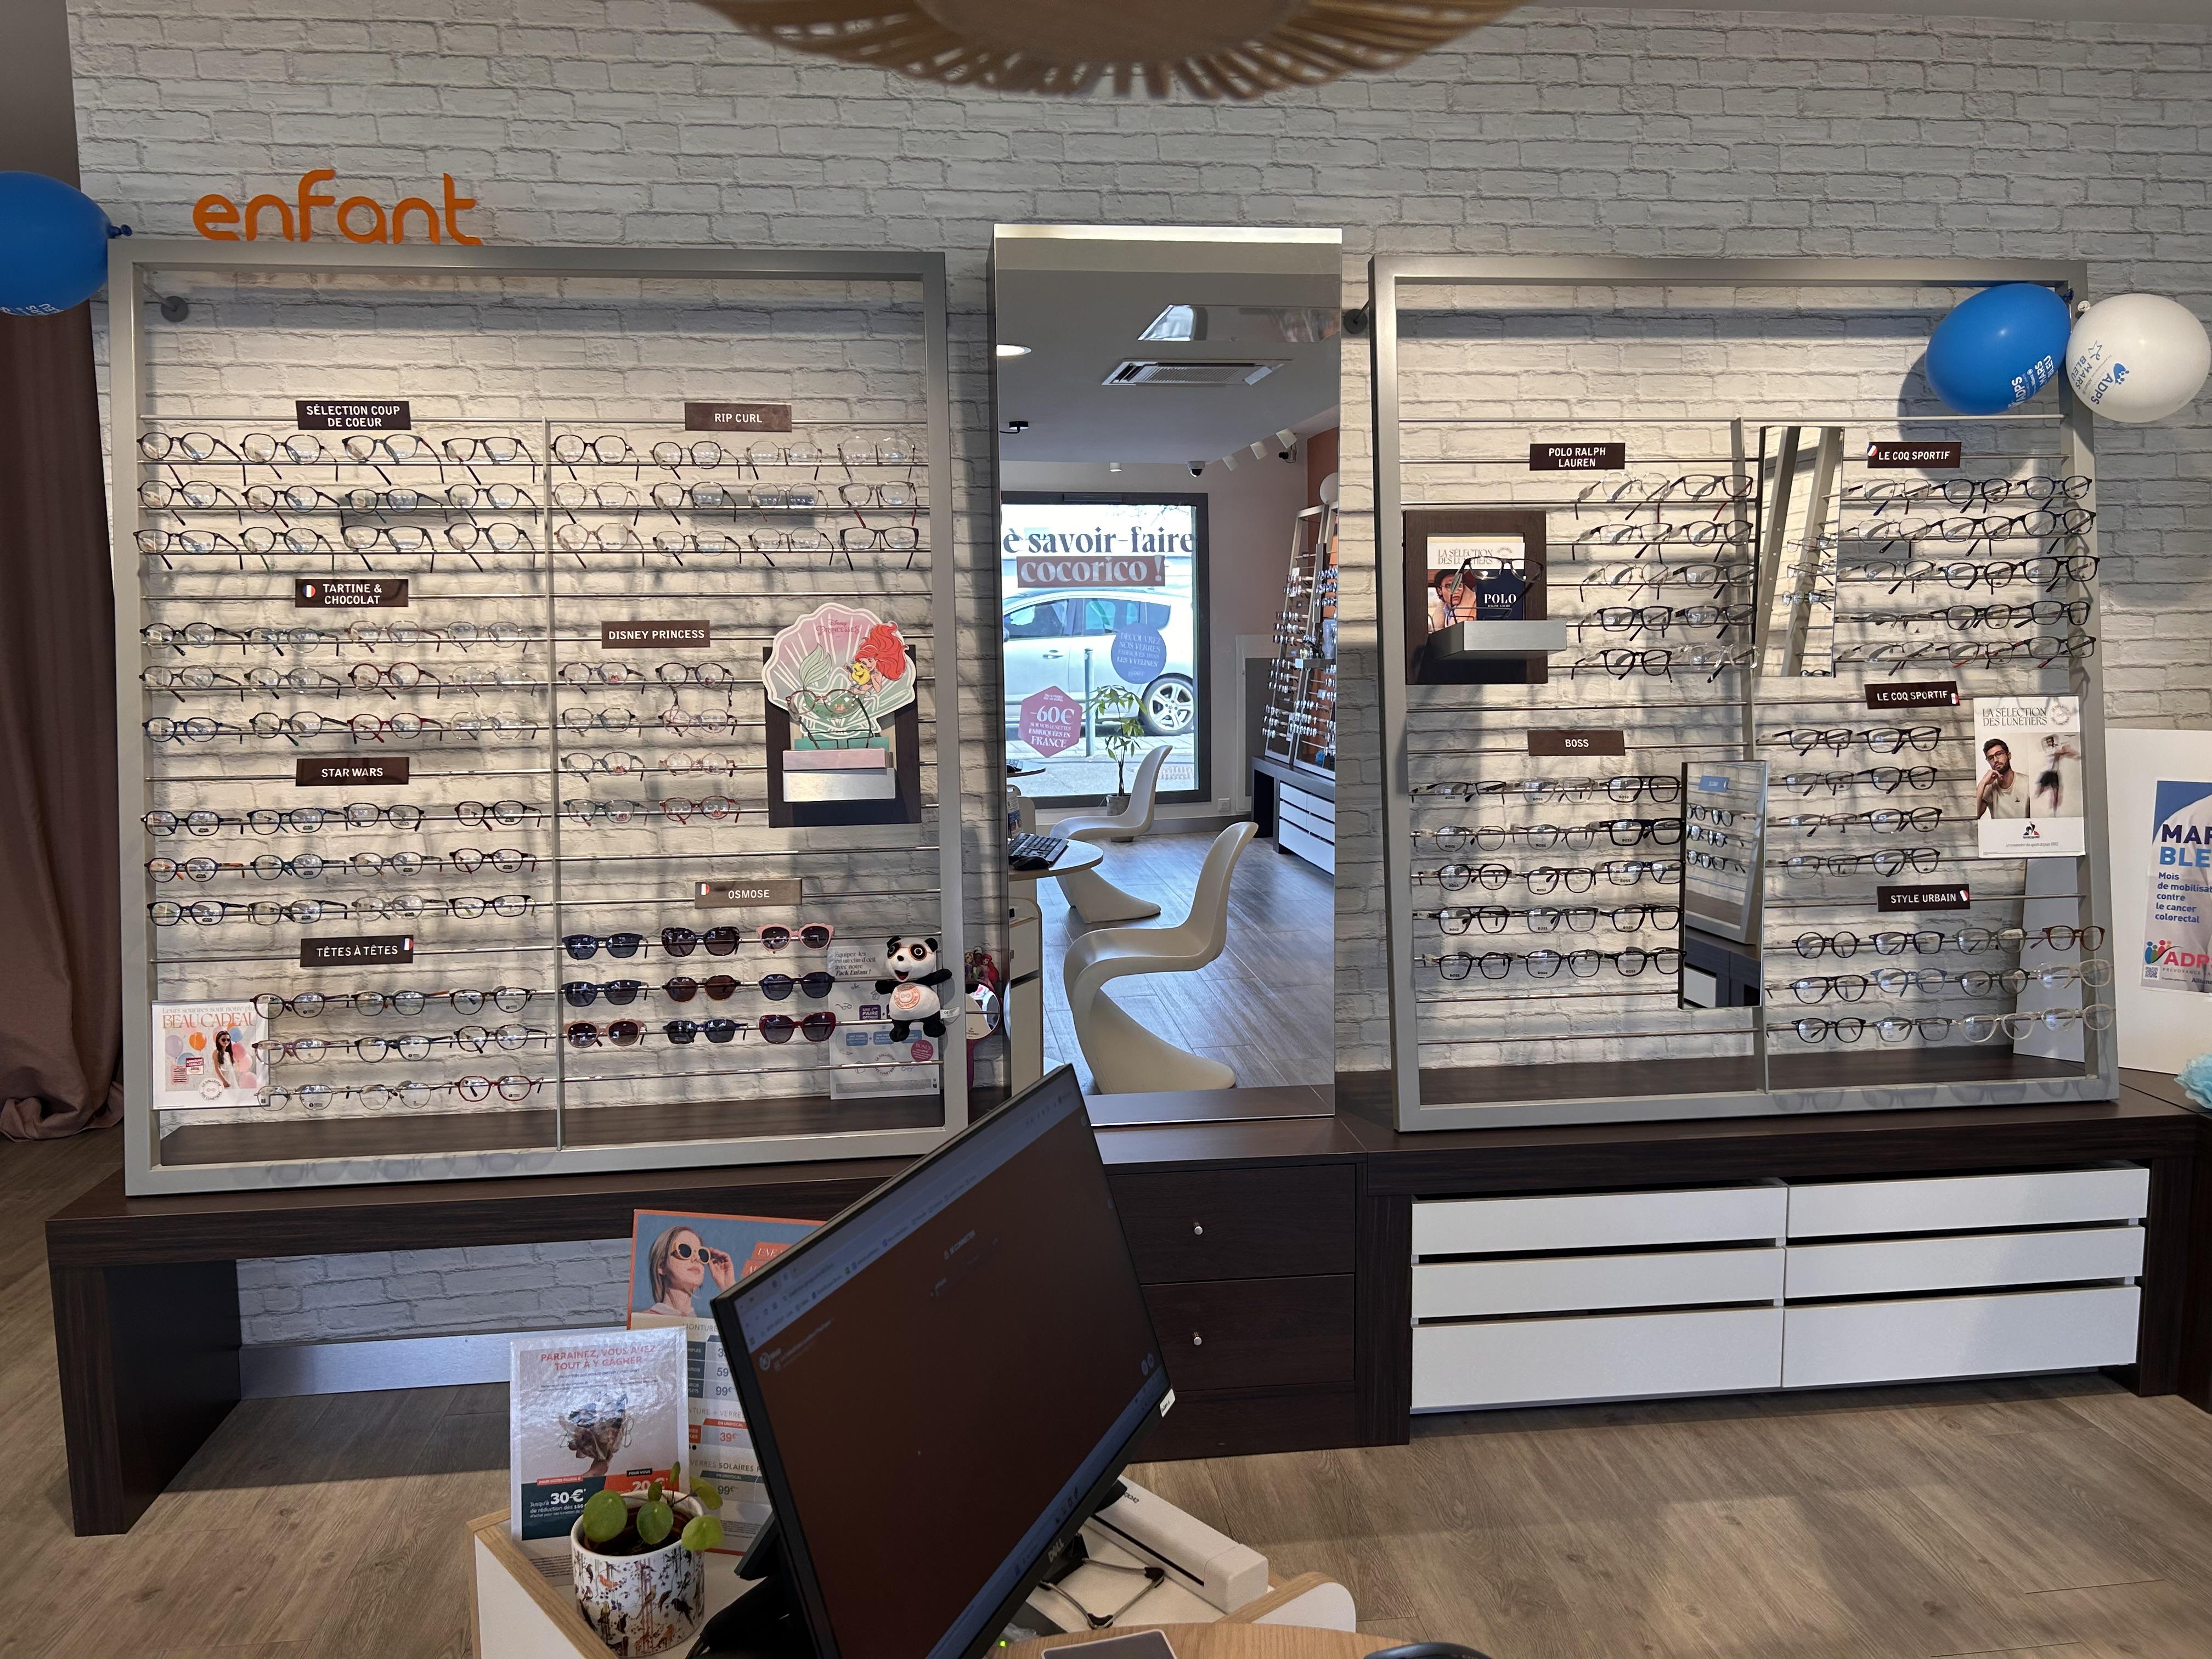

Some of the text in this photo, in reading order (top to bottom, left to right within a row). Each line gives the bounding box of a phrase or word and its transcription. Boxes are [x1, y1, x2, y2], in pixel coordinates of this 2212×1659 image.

[193, 169, 483, 245] enfant
[2044, 355, 2055, 378] BLEU
[2071, 355, 2087, 381] BLEU
[2035, 361, 2046, 386] MARS
[2075, 362, 2093, 390] MARS
[2012, 376, 2026, 402] ADPS
[2091, 373, 2113, 404] ADPS
[306, 403, 400, 415] SÉLECTION COUP
[328, 417, 382, 427] DE COEUR
[714, 413, 763, 423] RIP CURL
[1549, 447, 1606, 457] POLO RALPH
[1878, 451, 1950, 461] LE COQ SPORTIF
[1559, 458, 1596, 467] LAUREN
[1028, 526, 1195, 554] savoir-faire
[1438, 548, 1493, 557] LA SÉLECTION
[1020, 554, 1163, 583] cocorico !
[323, 584, 382, 593] TARTINE &
[324, 595, 381, 605] CHOCOLAT
[1484, 594, 1516, 604] POLO
[608, 629, 705, 640] DISNEY PRINCESS
[1877, 690, 1948, 701] LE COQ SPORTIF
[1983, 706, 2047, 718] LA SÉLECTION
[1983, 716, 2047, 726] DES LUNETIERS
[1031, 736, 1066, 748] FRANCE
[1565, 738, 1589, 748] BOSS
[321, 767, 383, 778] STAR WARS
[2158, 871, 2180, 880] Mois
[728, 889, 770, 899] OSMOSE
[1891, 893, 1956, 904] STYLE URBAIN
[2157, 893, 2186, 901] contre
[2166, 904, 2197, 912] cancer
[2155, 913, 2200, 923] colorectal
[316, 944, 398, 957] TÊTES À TÊTES
[2163, 951, 2212, 969] ADP
[163, 1012, 258, 1029] BEAU CADEAU
[554, 1362, 580, 1370] TOUT
[719, 1463, 754, 1472] SOLAIRES
[1048, 1537, 1064, 1562] DELL
